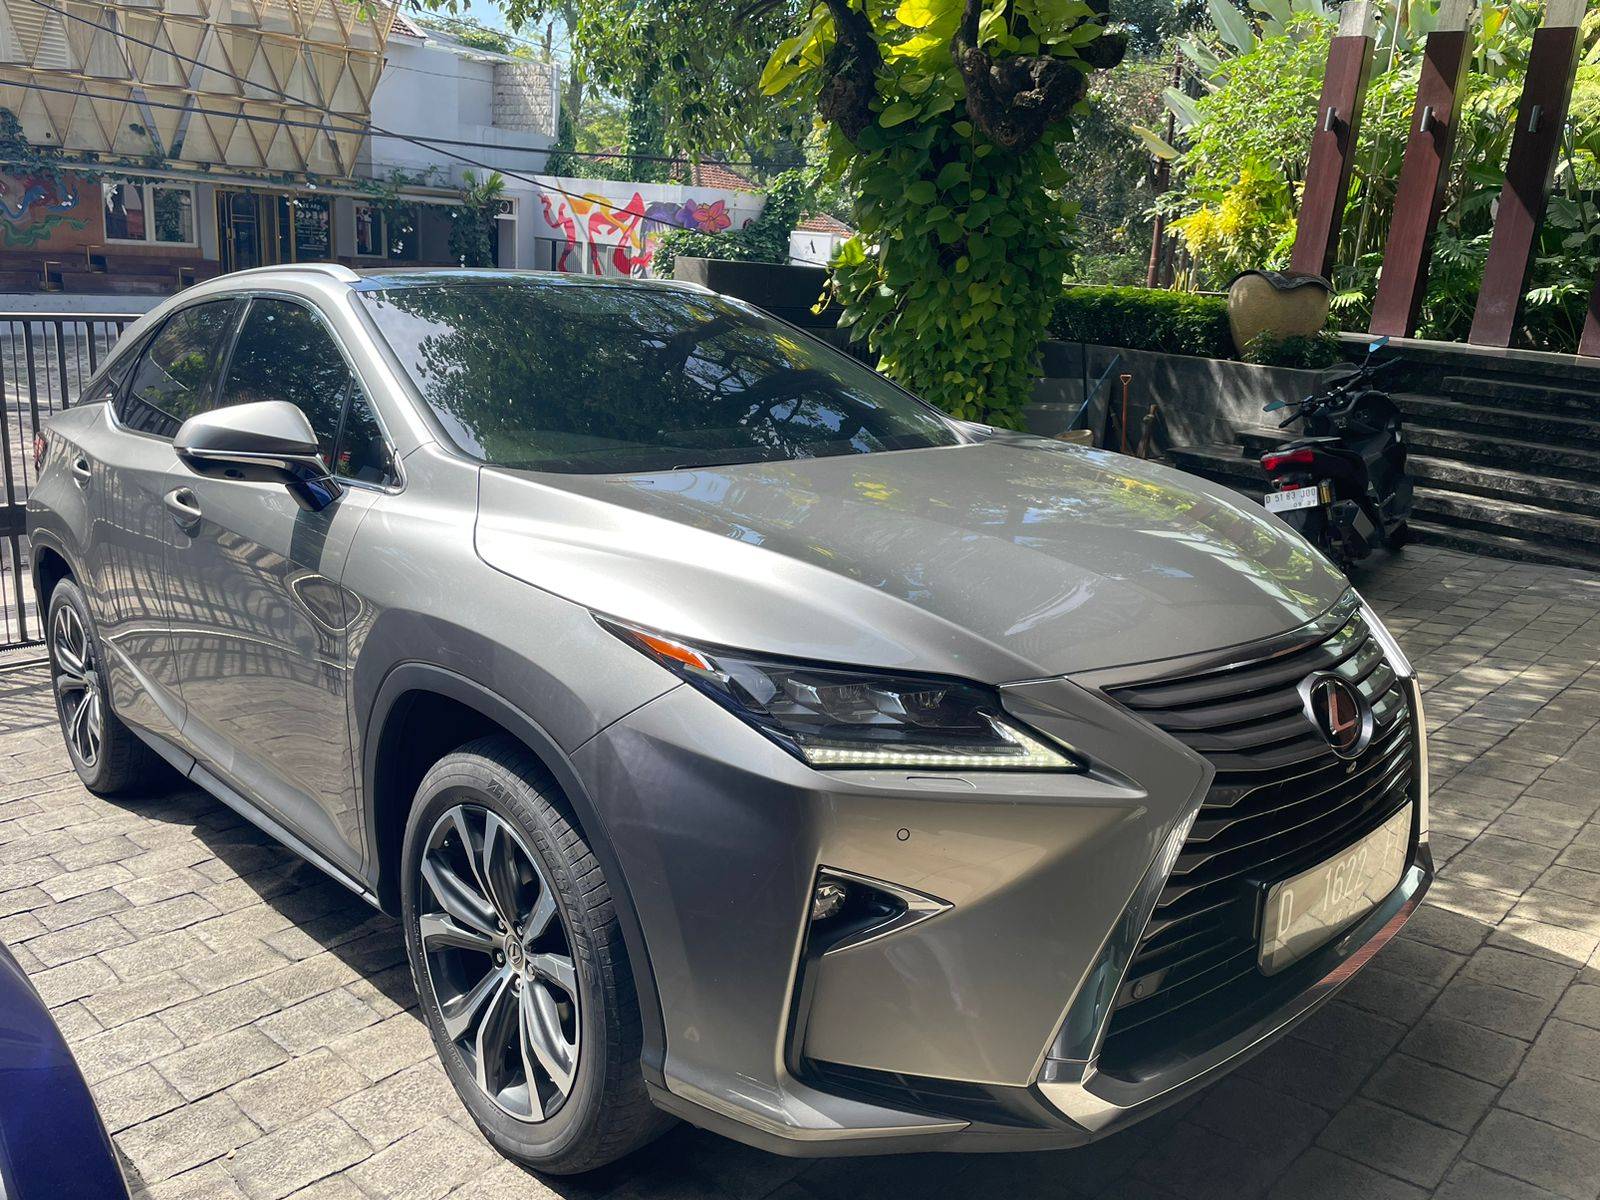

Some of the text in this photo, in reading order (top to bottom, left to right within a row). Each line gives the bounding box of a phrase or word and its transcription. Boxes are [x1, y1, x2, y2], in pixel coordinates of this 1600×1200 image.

[1265, 495, 1271, 504] D
[1277, 889, 1295, 938] D
[1323, 846, 1368, 912] 1622
